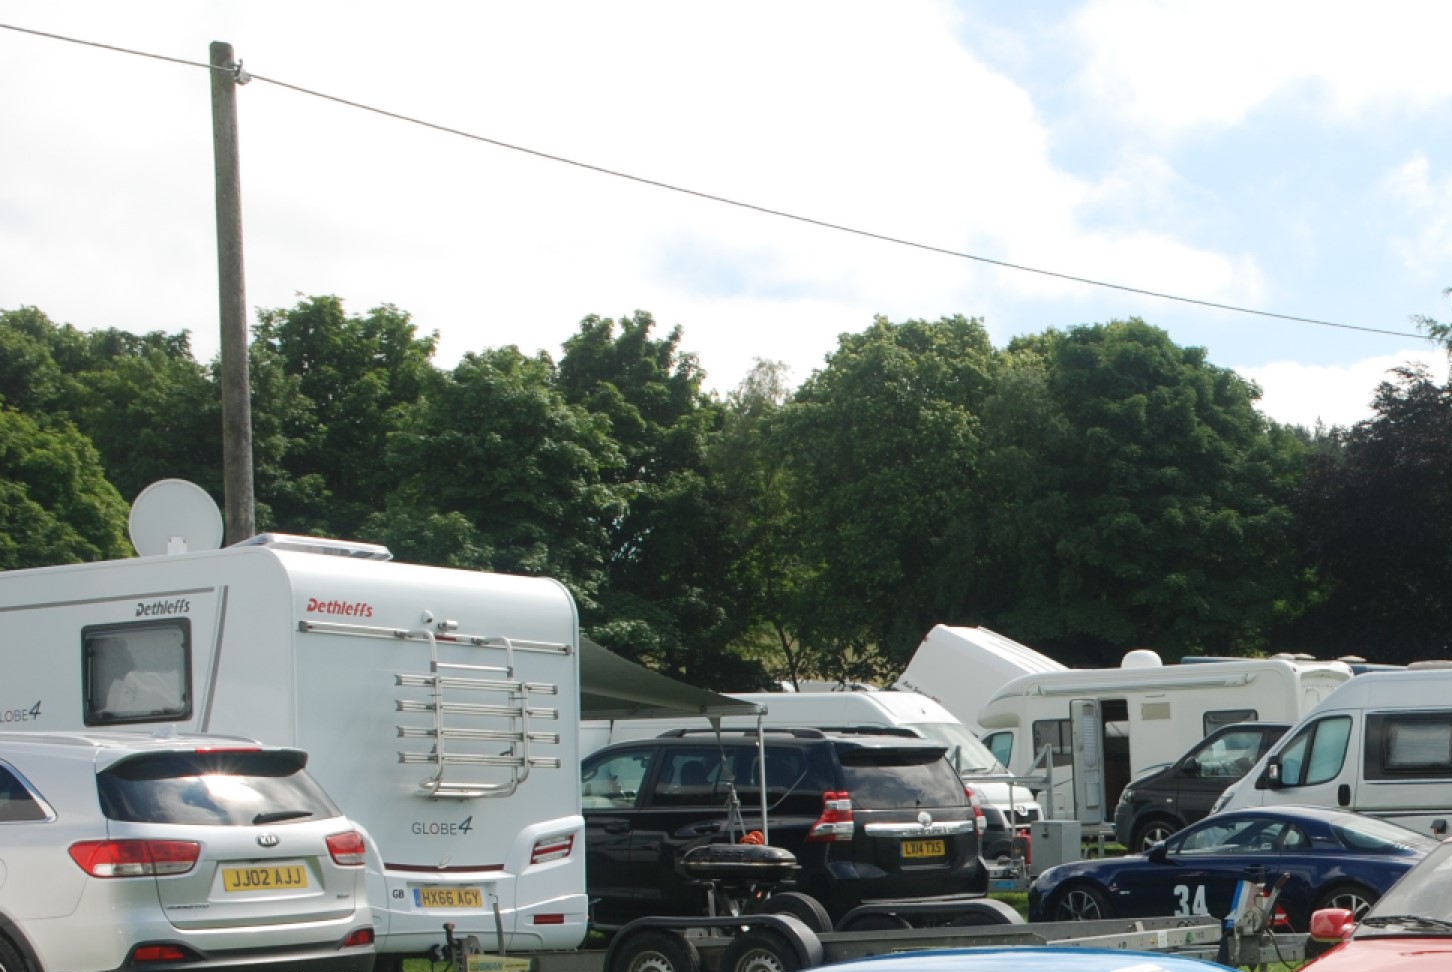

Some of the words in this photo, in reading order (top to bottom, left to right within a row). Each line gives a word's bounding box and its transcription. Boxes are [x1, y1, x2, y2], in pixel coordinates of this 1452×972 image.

[136, 599, 190, 617] Dethleffs
[306, 597, 373, 618] Dethleffs
[0, 700, 42, 723] LOBE4
[260, 836, 277, 845] KIA
[232, 868, 271, 888] JJ02
[274, 866, 302, 886] AJJ
[392, 889, 405, 899] GB
[422, 891, 454, 905] HX66
[458, 890, 479, 905] AGY
[1173, 884, 1209, 917] 34
